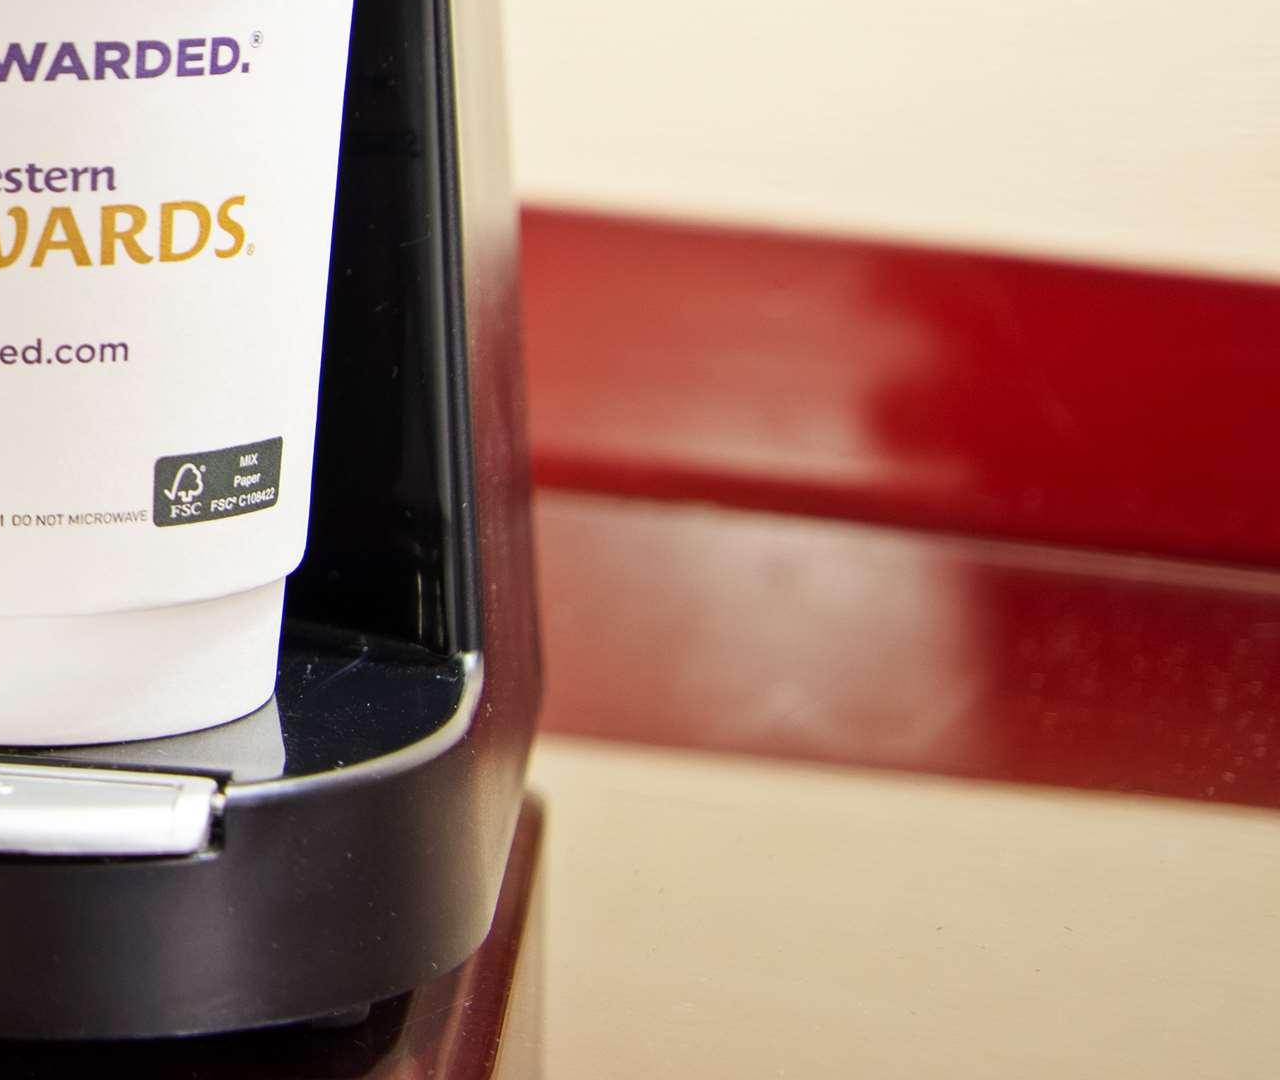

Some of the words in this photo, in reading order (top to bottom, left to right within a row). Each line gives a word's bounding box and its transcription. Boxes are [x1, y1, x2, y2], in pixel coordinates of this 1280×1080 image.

[239, 452, 259, 468] MIX
[233, 473, 261, 488] Paper
[11, 513, 33, 527] DO
[35, 513, 65, 527] NOT
[67, 509, 148, 527] MICROWAVE
[170, 501, 203, 519] FSC
